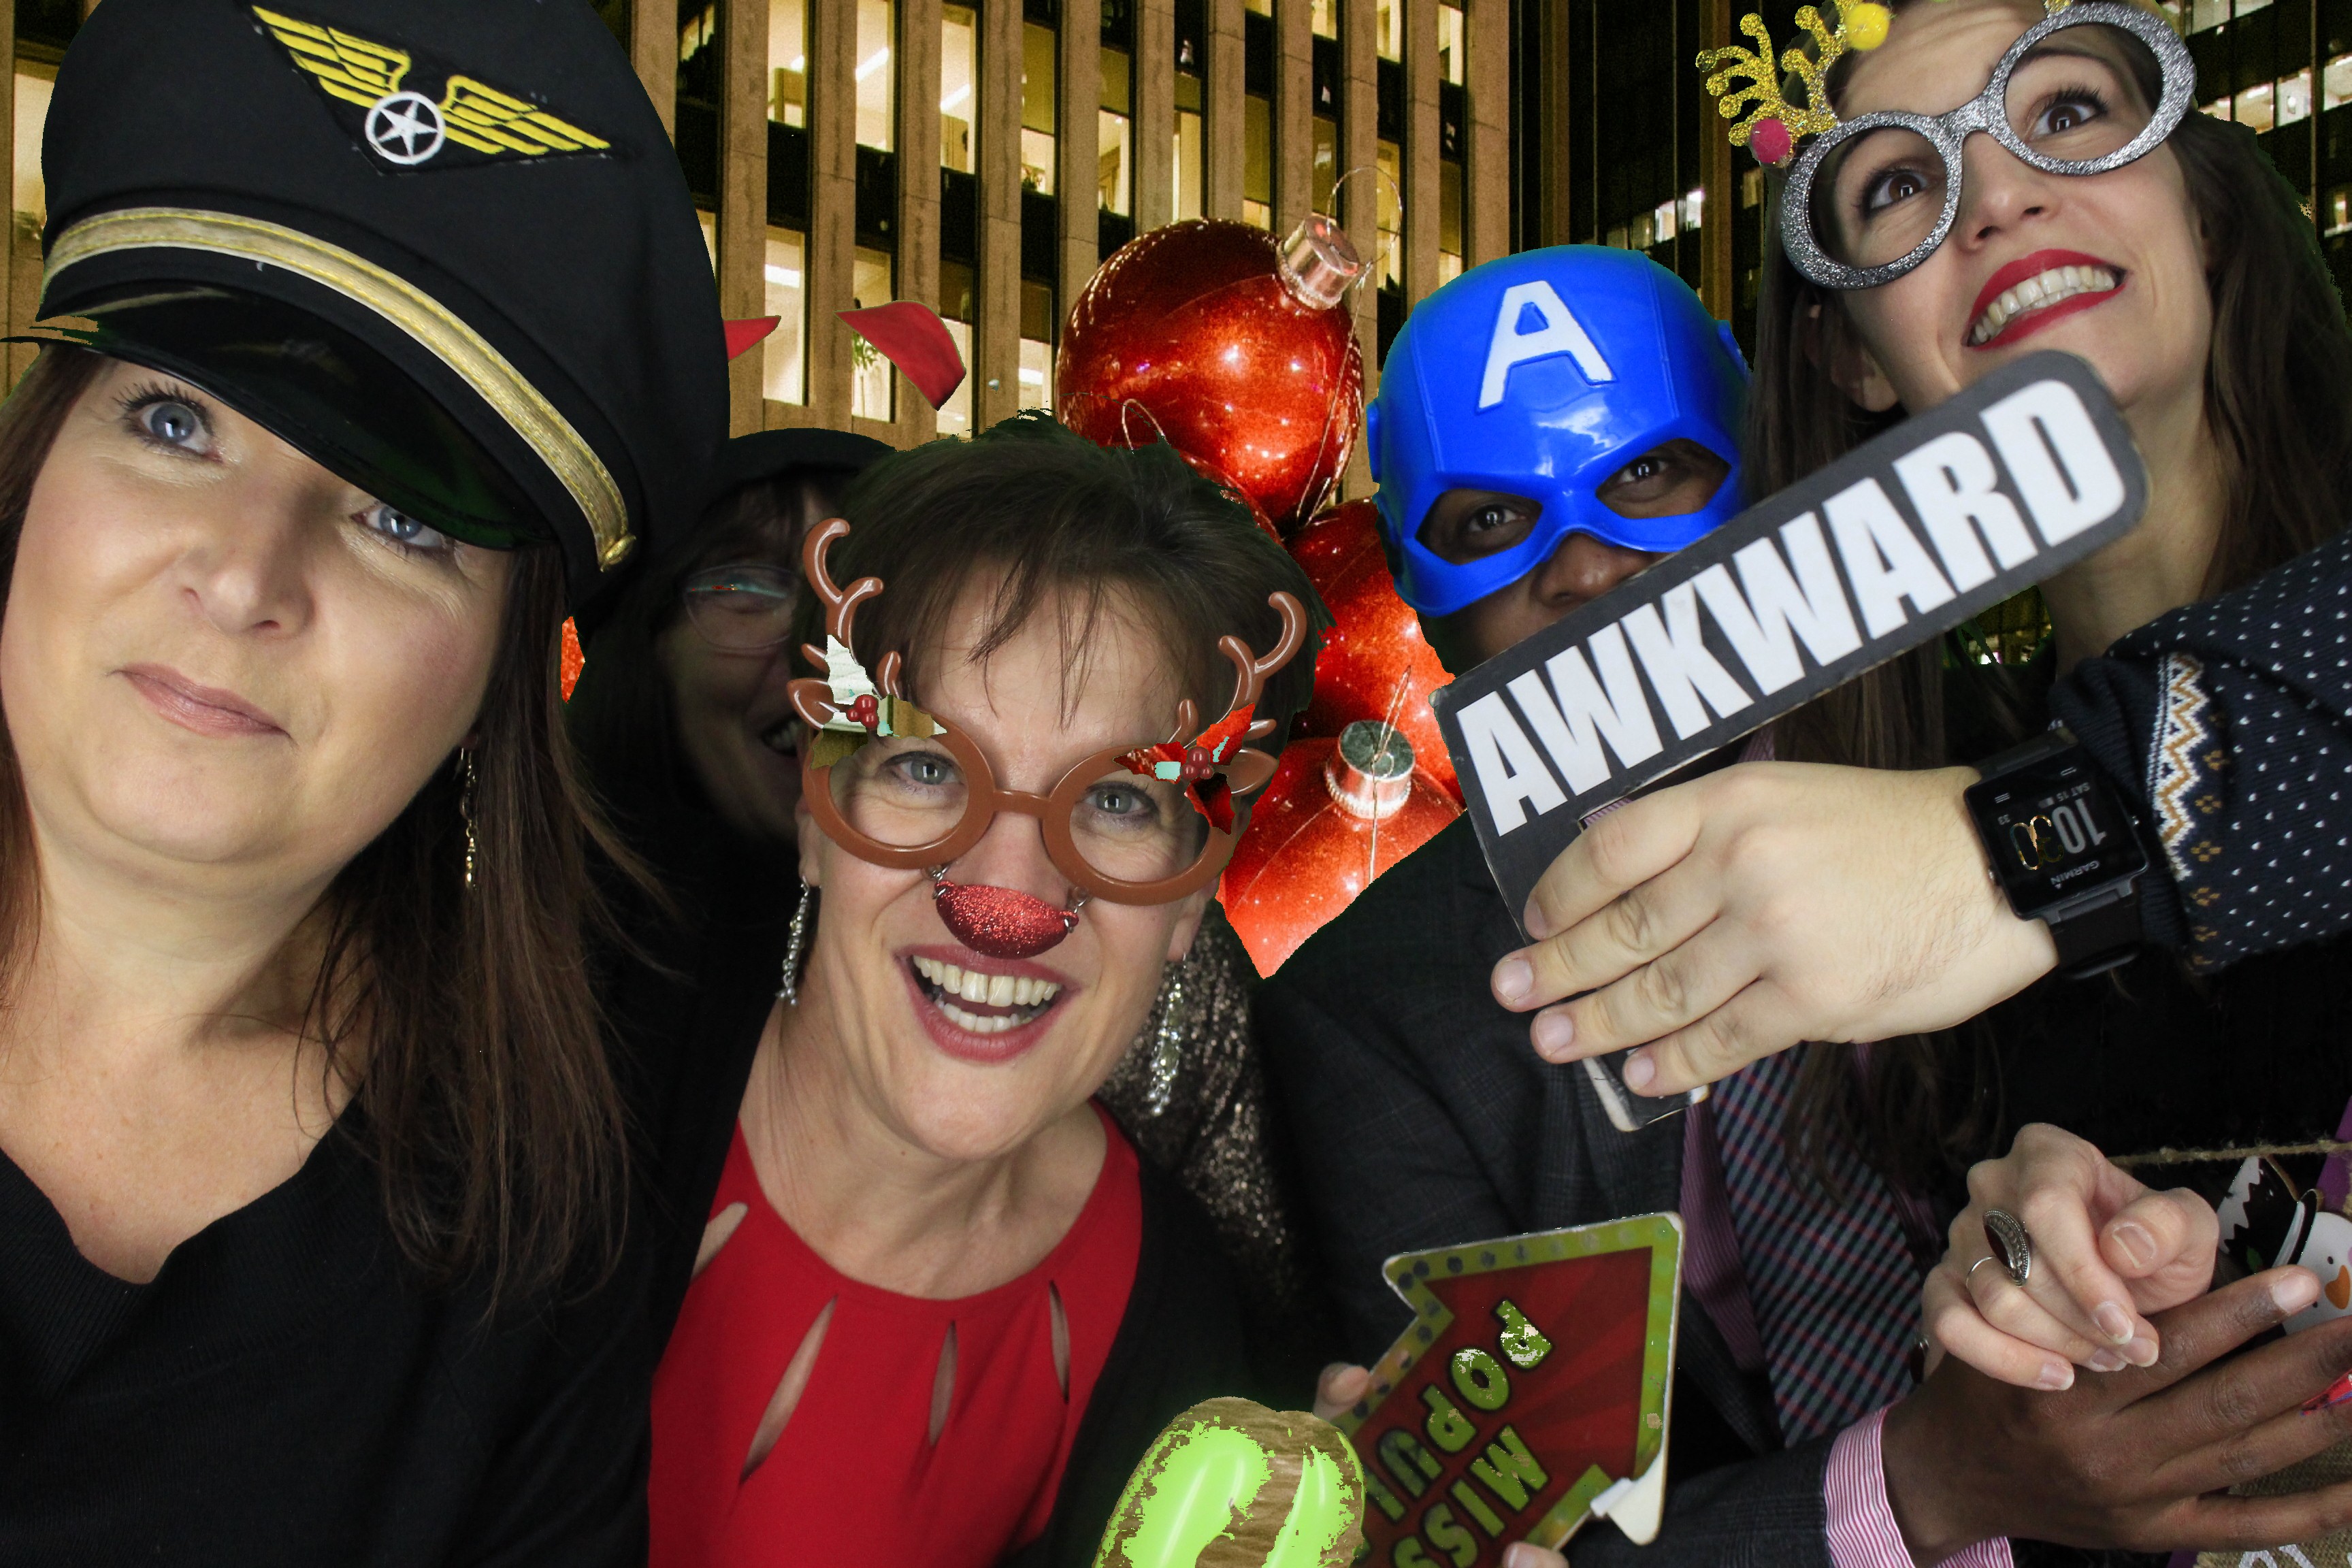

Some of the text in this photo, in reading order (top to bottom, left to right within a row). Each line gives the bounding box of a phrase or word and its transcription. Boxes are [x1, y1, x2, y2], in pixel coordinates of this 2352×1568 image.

[1478, 280, 1614, 409] A
[1457, 380, 2127, 836] AWKWARD
[2050, 860, 2100, 886] GARMIN
